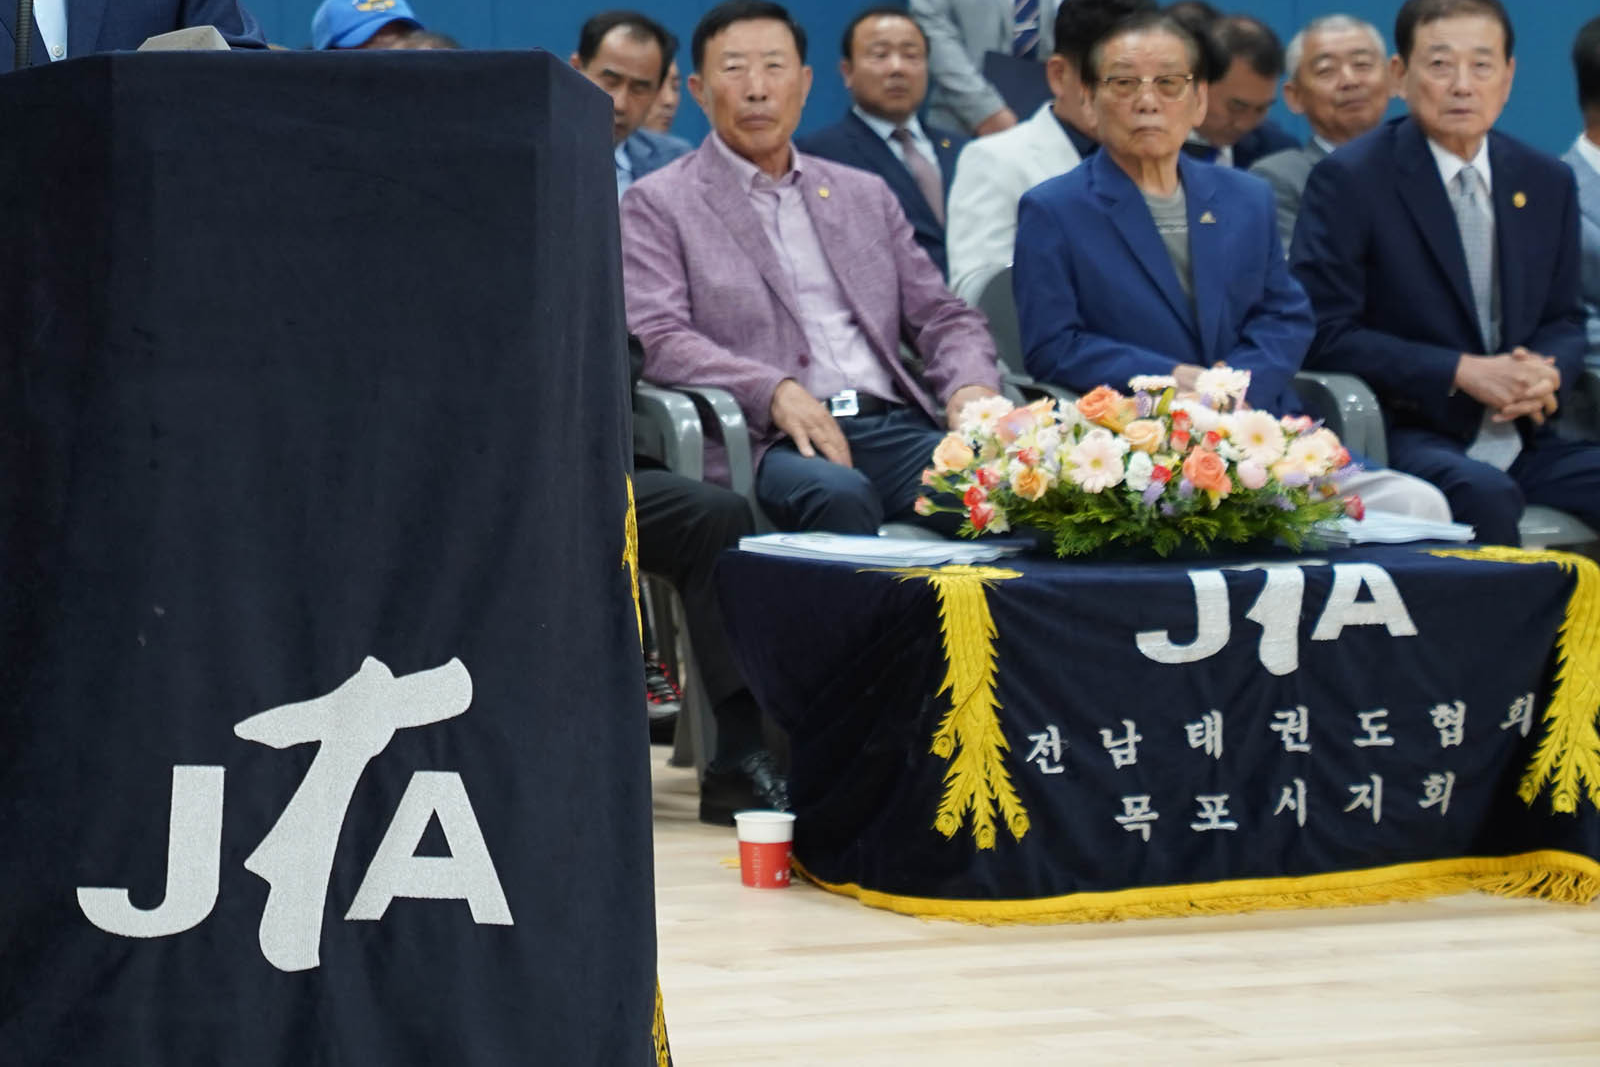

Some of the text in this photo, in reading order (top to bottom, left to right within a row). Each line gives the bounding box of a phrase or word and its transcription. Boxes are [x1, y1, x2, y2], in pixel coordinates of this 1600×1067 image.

[1026, 693, 1536, 775] 전남태권도협회
[76, 655, 515, 973] JTA
[1114, 771, 1457, 842] 목포시지회
